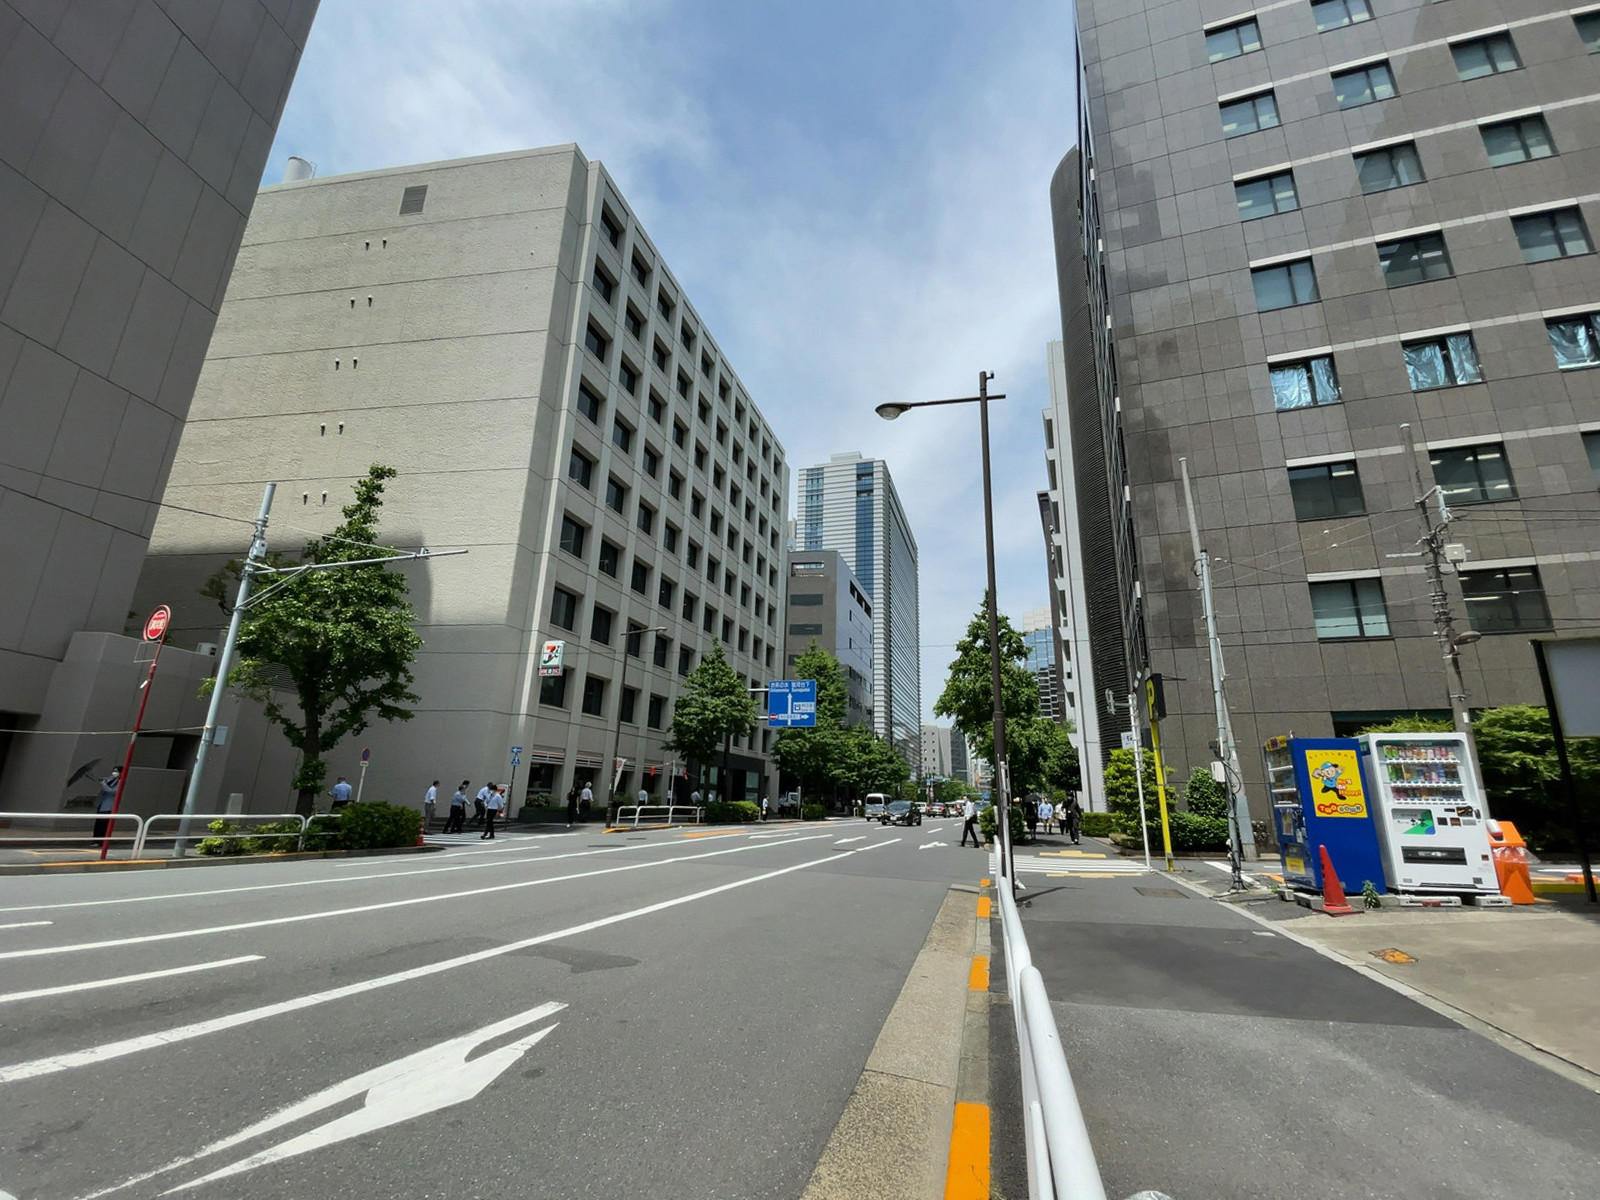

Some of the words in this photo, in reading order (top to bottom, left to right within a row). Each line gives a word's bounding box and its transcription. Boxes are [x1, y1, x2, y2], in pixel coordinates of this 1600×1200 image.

[1146, 679, 1155, 719] P
[1319, 804, 1337, 814] TWO
[1339, 804, 1361, 813] DOWN
